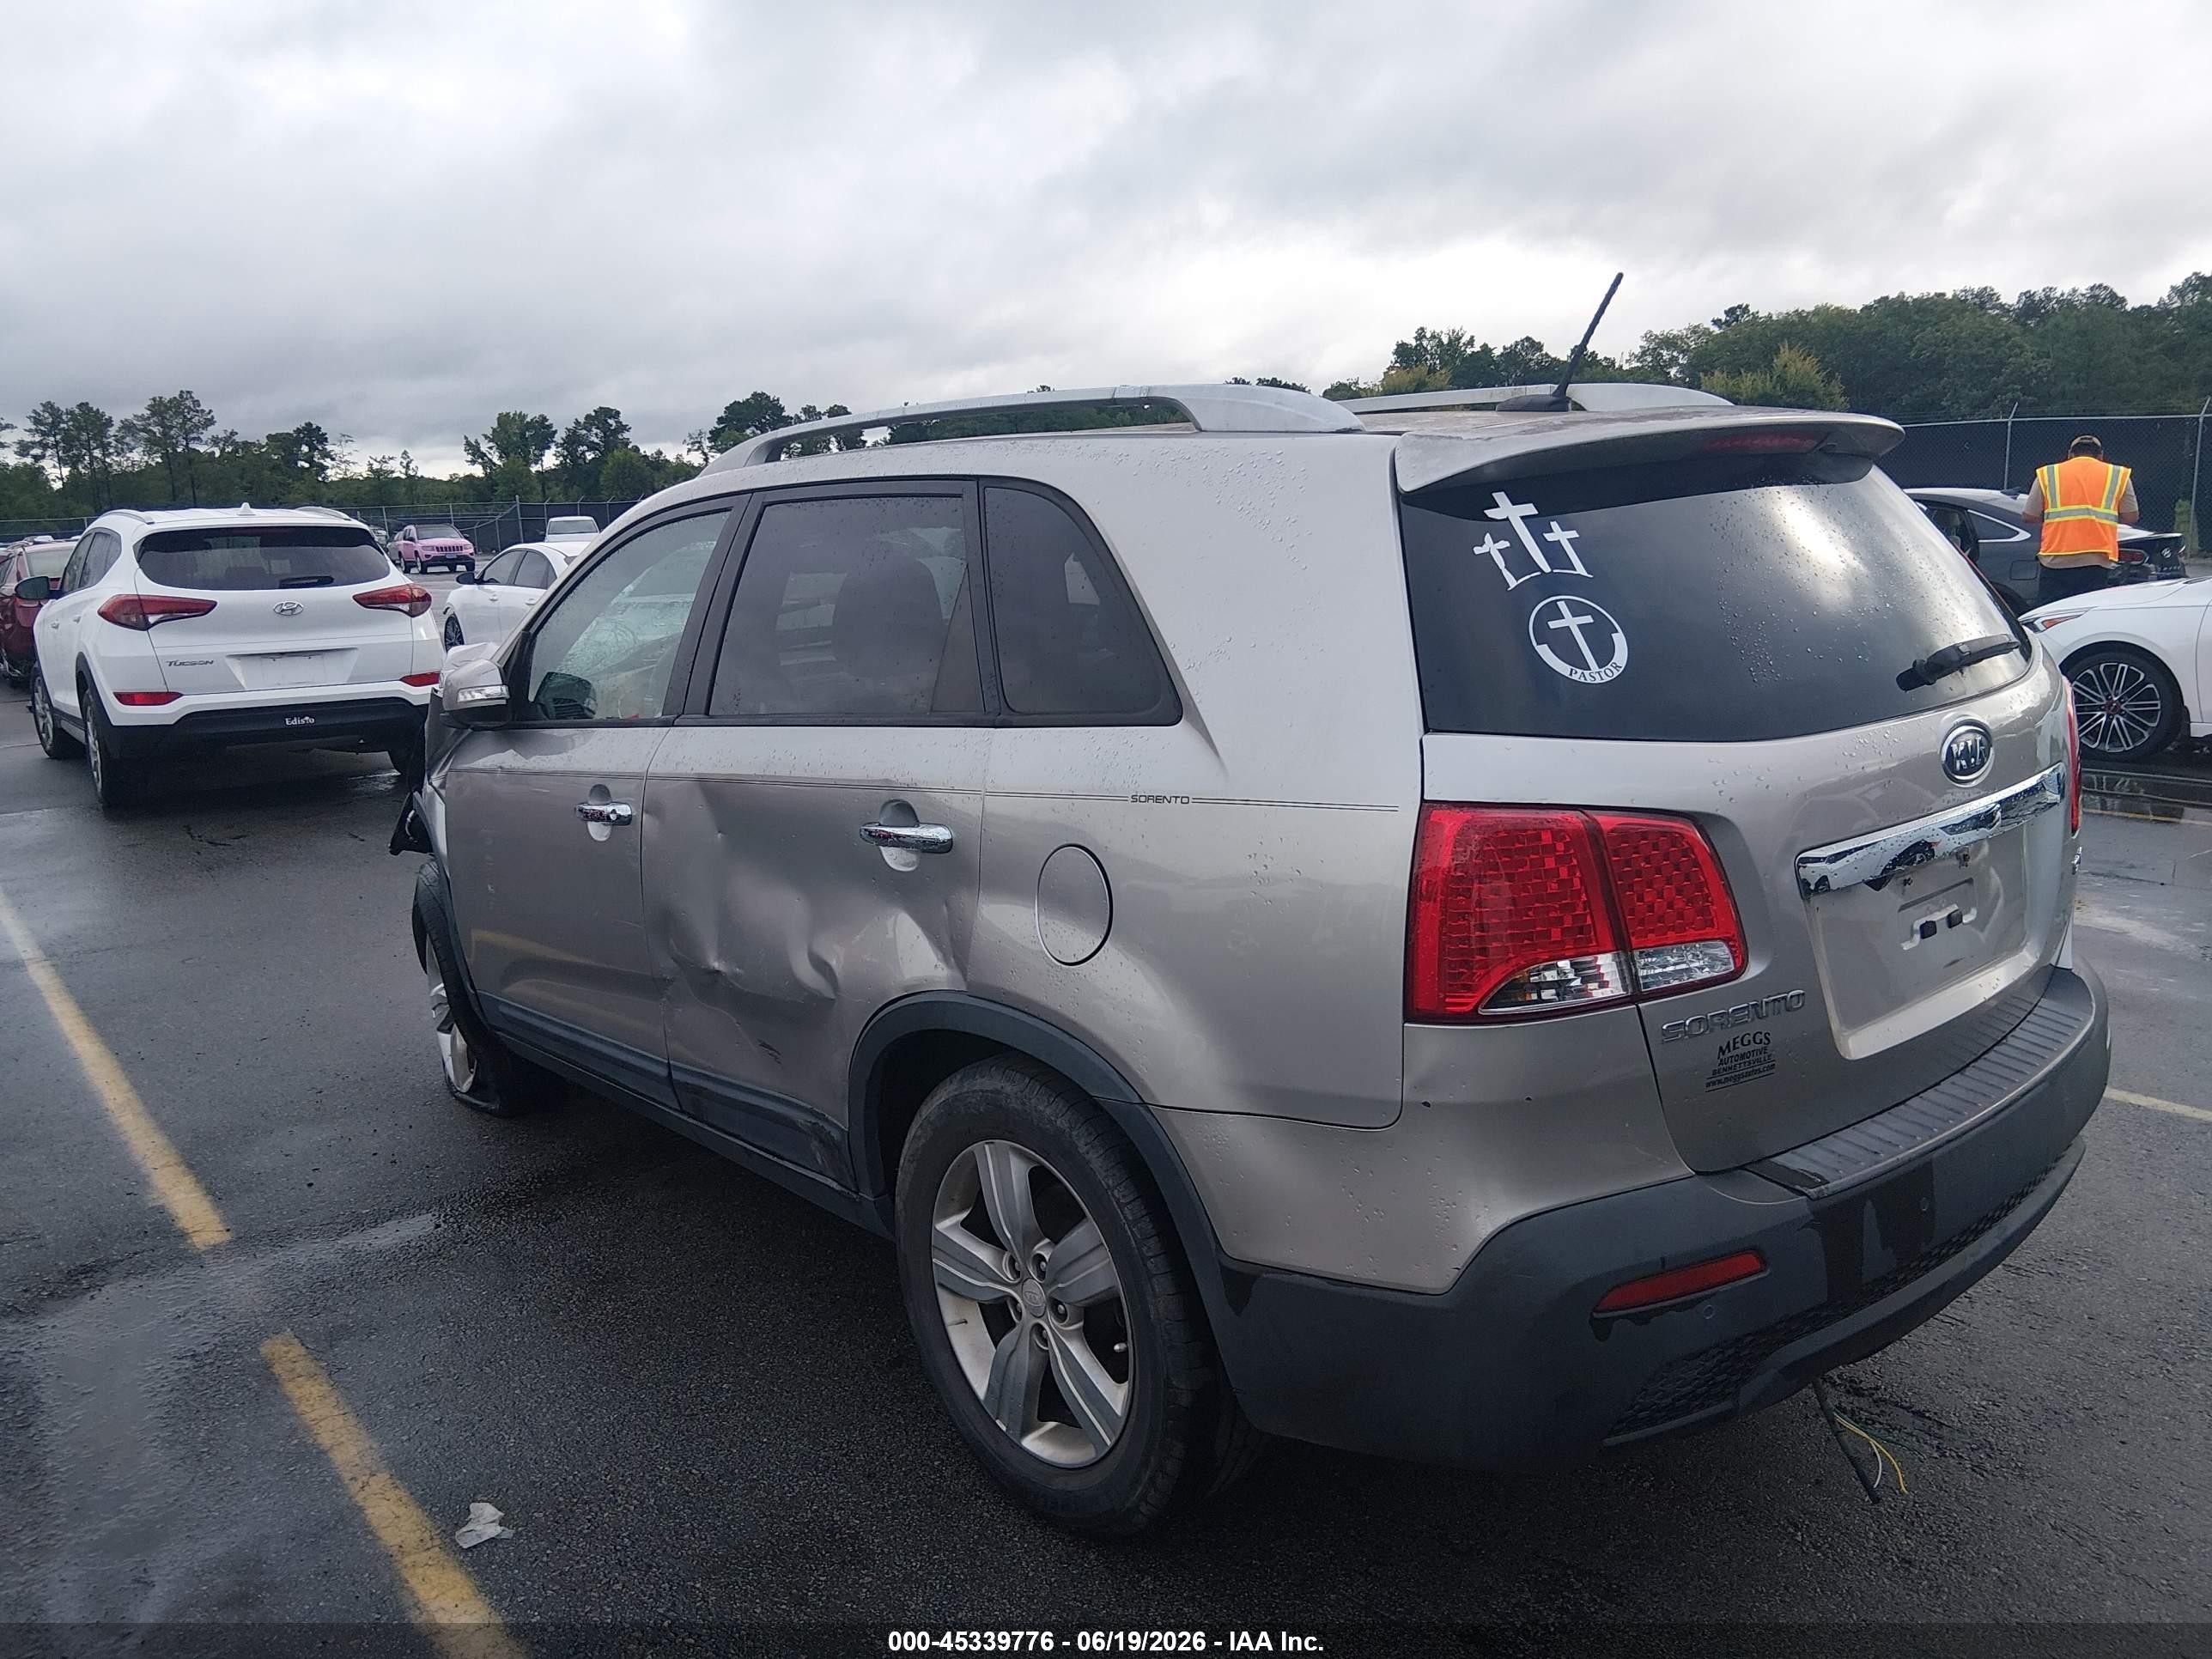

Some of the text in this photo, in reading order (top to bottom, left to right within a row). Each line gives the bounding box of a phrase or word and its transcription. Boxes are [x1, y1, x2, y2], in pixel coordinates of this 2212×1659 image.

[166, 659, 214, 667] TUCSON
[1568, 661, 1623, 683] PASTOR
[1950, 734, 1988, 771] KIA
[1130, 794, 1190, 805] SORENTO
[1662, 989, 1806, 1043] SORENTO
[1717, 1031, 1771, 1060] MEGGS
[1718, 1046, 1769, 1066] AUTOMOTIVE
[1712, 1054, 1772, 1075] BENNETTSVILLE
